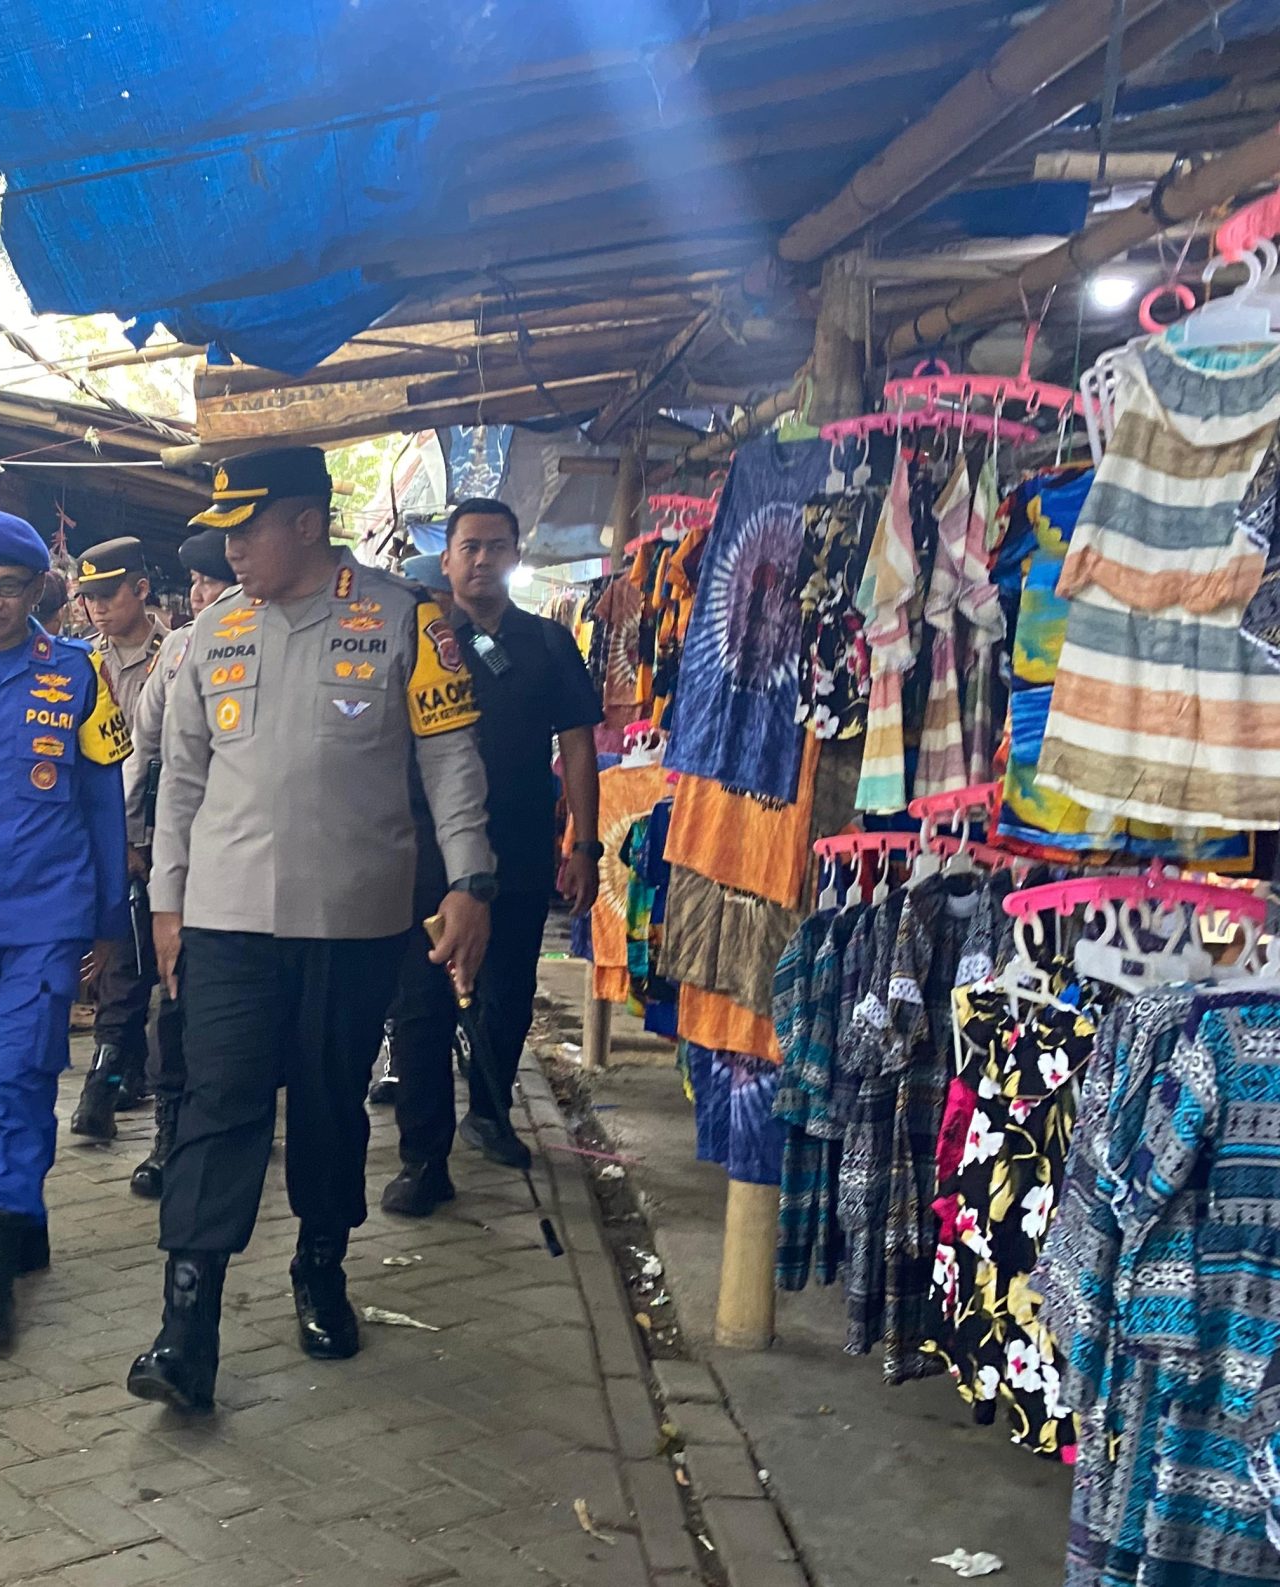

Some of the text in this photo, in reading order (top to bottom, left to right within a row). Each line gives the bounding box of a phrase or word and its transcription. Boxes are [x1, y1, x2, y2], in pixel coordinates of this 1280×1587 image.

[207, 643, 257, 661] INDRA
[330, 638, 387, 654] POLRI
[25, 708, 74, 730] POLRI
